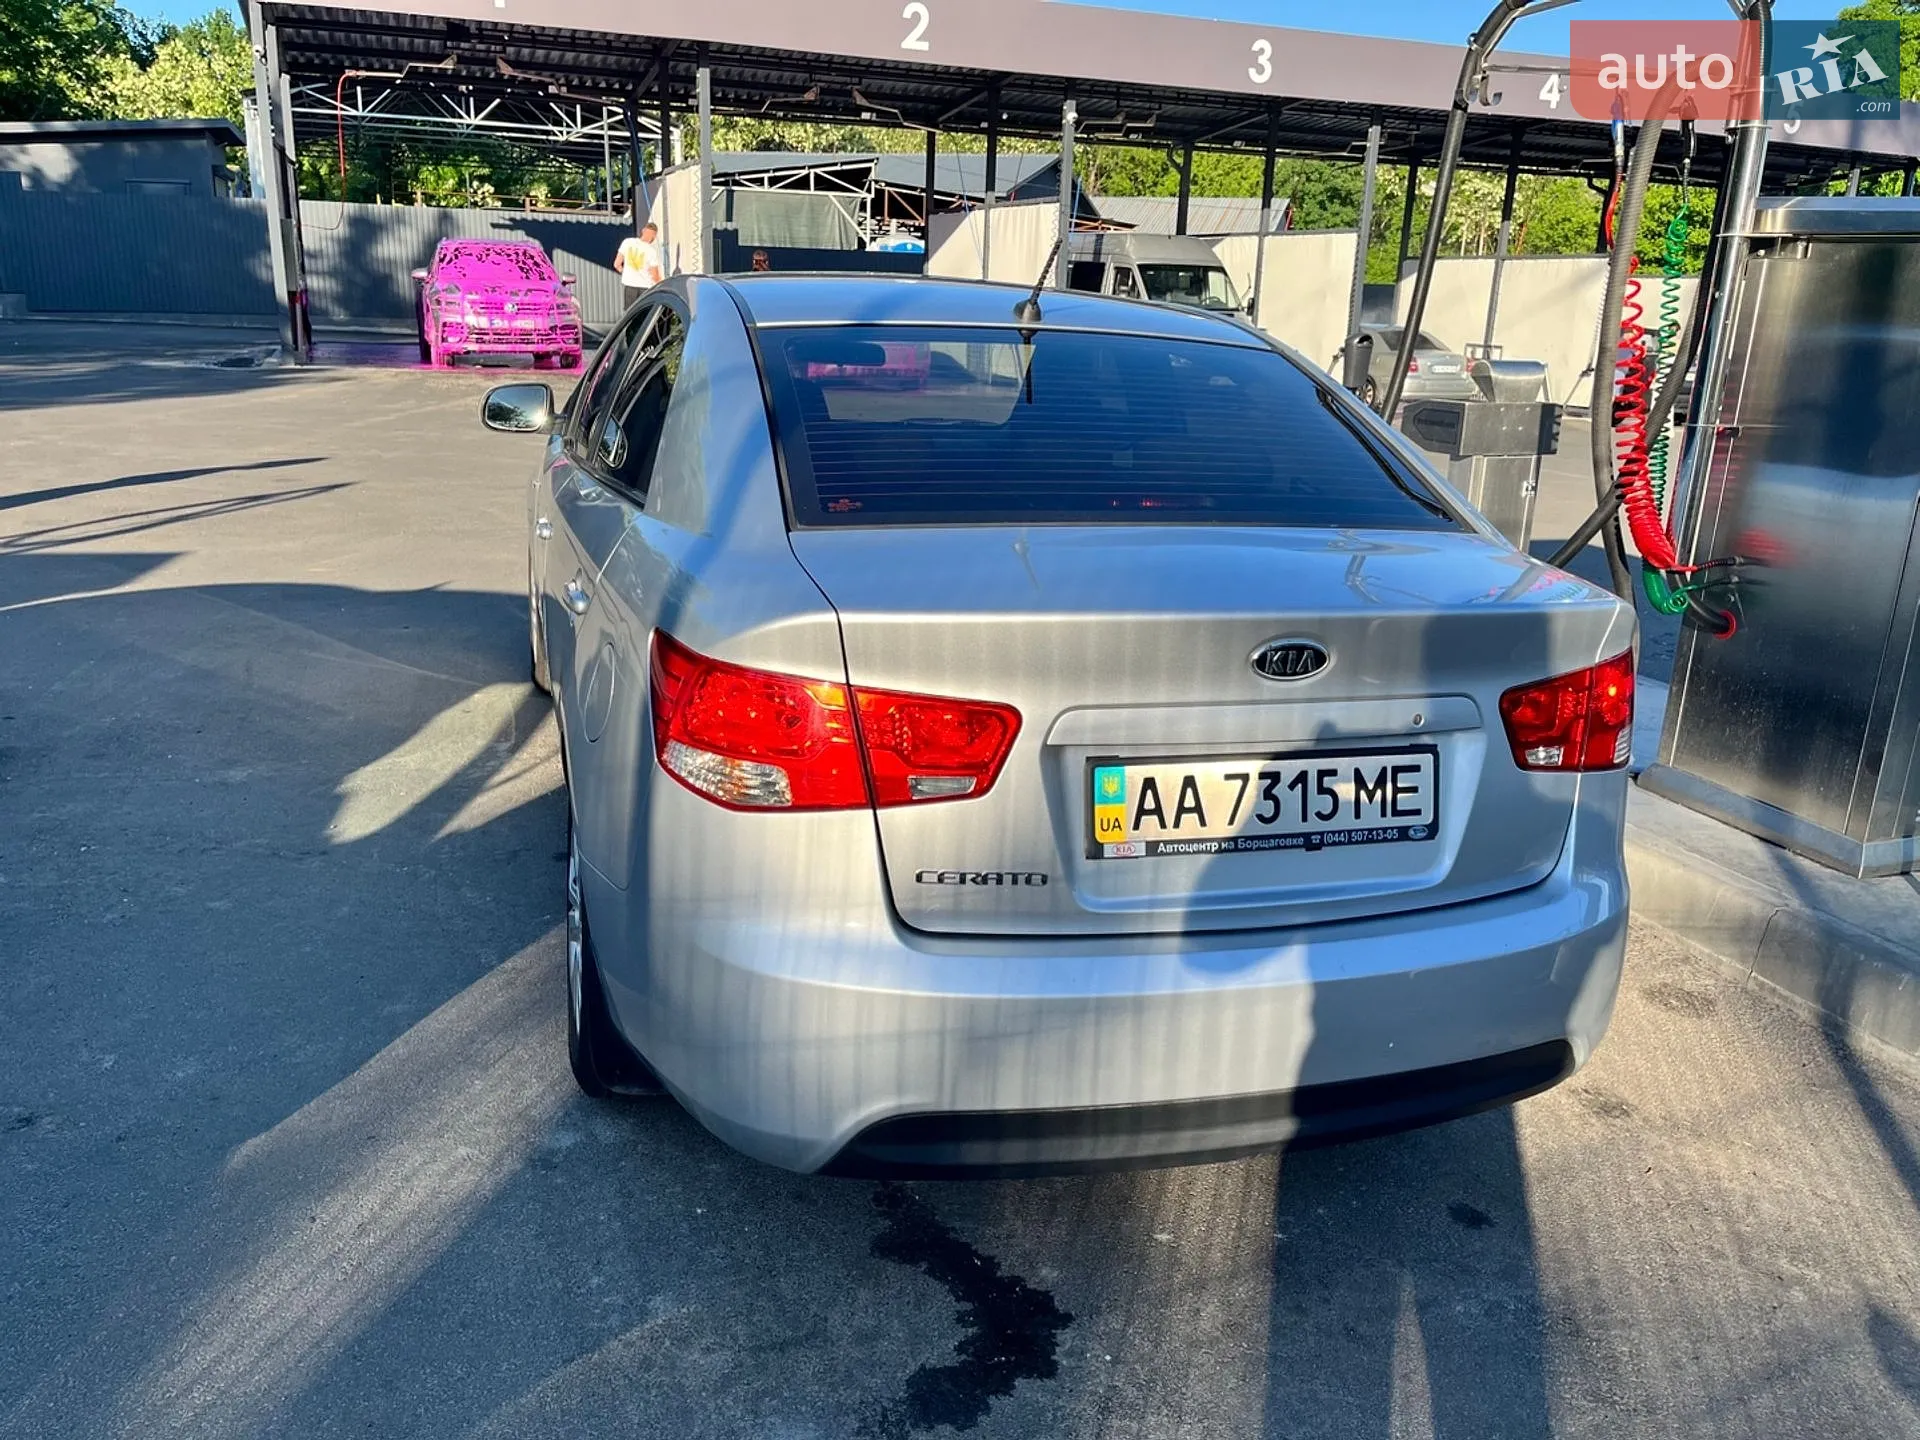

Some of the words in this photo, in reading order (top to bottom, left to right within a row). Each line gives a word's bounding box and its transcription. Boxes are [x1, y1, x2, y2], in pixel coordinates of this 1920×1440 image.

[901, 2, 930, 51] 2
[1248, 39, 1273, 84] 3
[1538, 73, 1562, 109] 4
[1265, 649, 1318, 674] KIA
[1132, 775, 1208, 831] AA
[1223, 768, 1339, 827] 7315
[1353, 764, 1422, 820] ME
[1100, 817, 1123, 833] UA
[1113, 844, 1135, 855] KIA
[1157, 839, 1219, 854] Автоцентр
[1237, 836, 1304, 850] Борщаговке
[1323, 831, 1349, 845] (044)
[1351, 828, 1399, 842] 507-13-05
[915, 869, 1048, 886] CERATO
